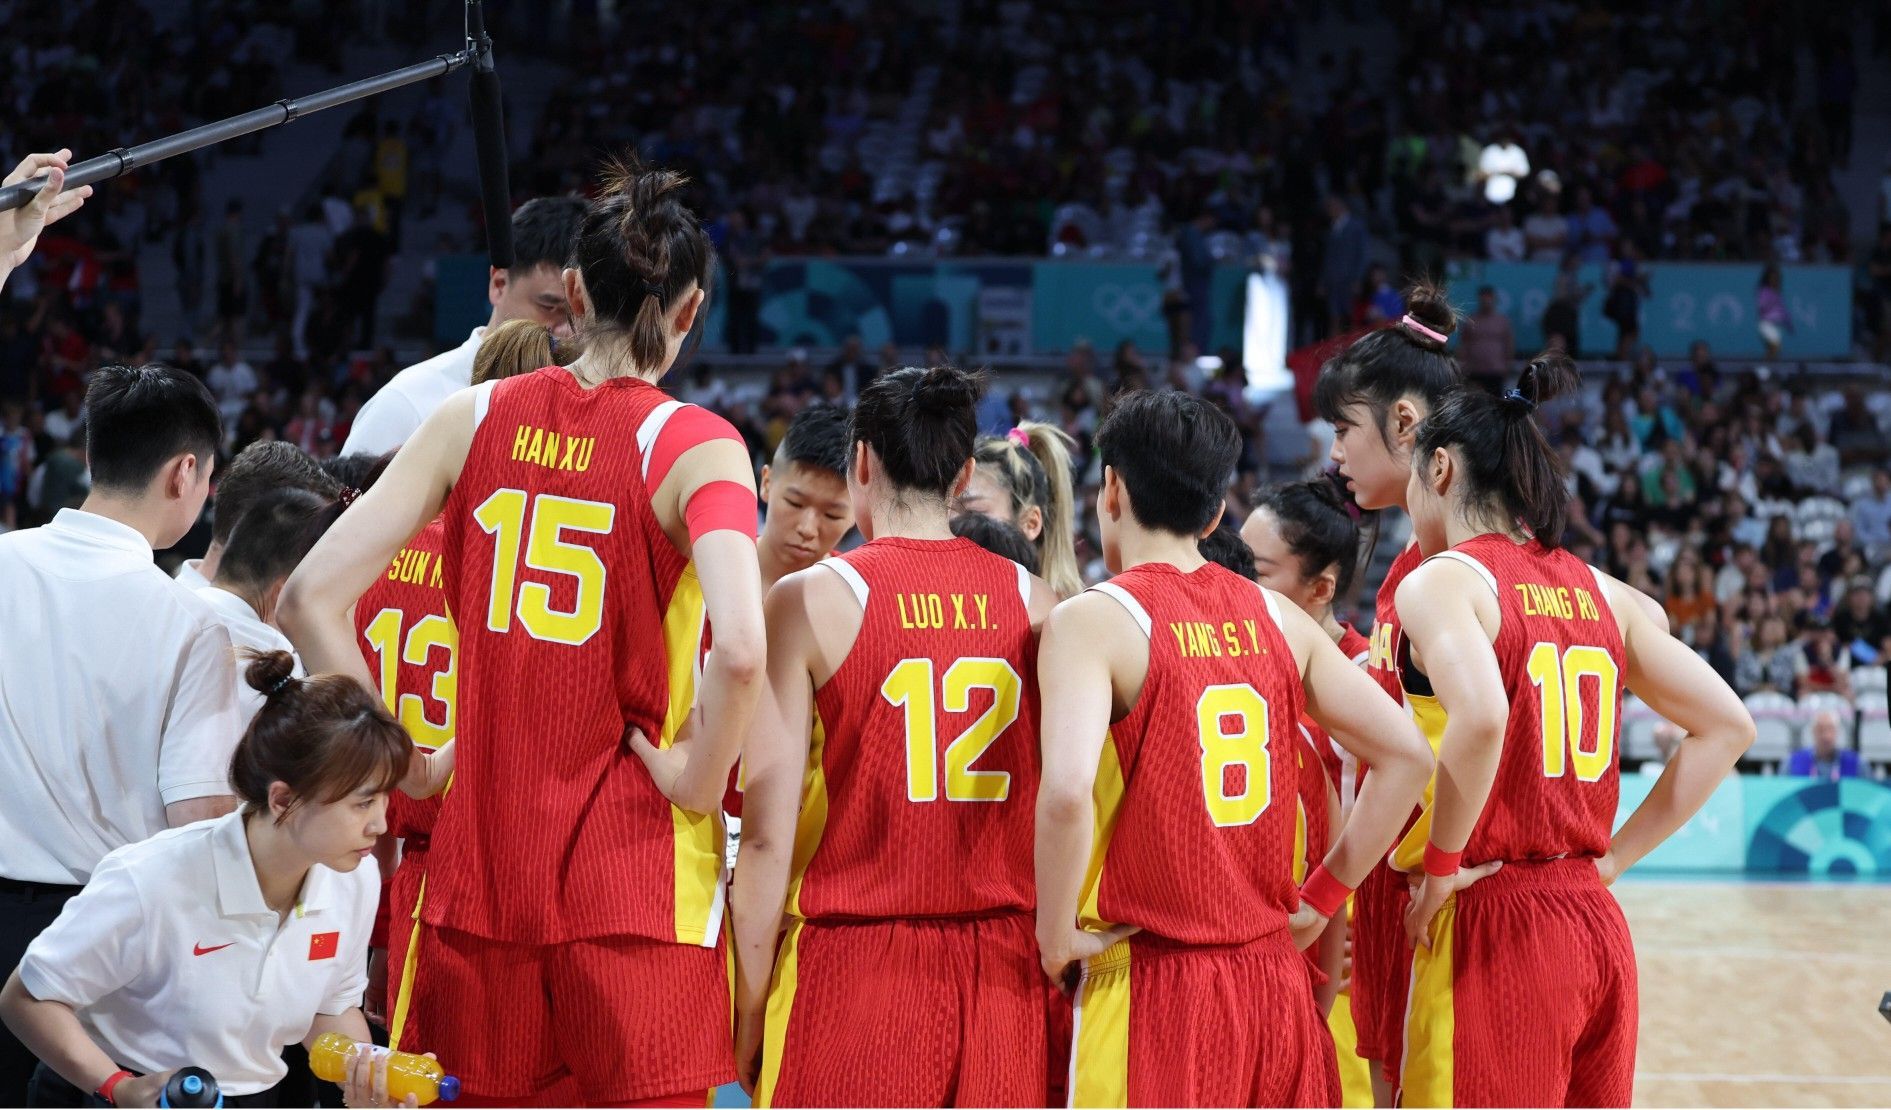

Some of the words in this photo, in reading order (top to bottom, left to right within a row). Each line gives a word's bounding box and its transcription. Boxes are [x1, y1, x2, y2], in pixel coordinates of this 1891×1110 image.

[511, 424, 560, 469] HAN
[558, 436, 595, 472] XU
[387, 548, 431, 585] SUN
[473, 487, 616, 646] 15
[896, 593, 944, 629] LUO
[950, 593, 998, 630] X.Y.
[1515, 583, 1573, 621] ZHANG
[1573, 587, 1600, 622] RU
[364, 607, 459, 750] 13
[1169, 621, 1222, 658] YANG
[1222, 619, 1268, 657] S.Y.
[880, 657, 1023, 802] 12
[1196, 683, 1271, 828] 8
[1526, 641, 1619, 783] 10
